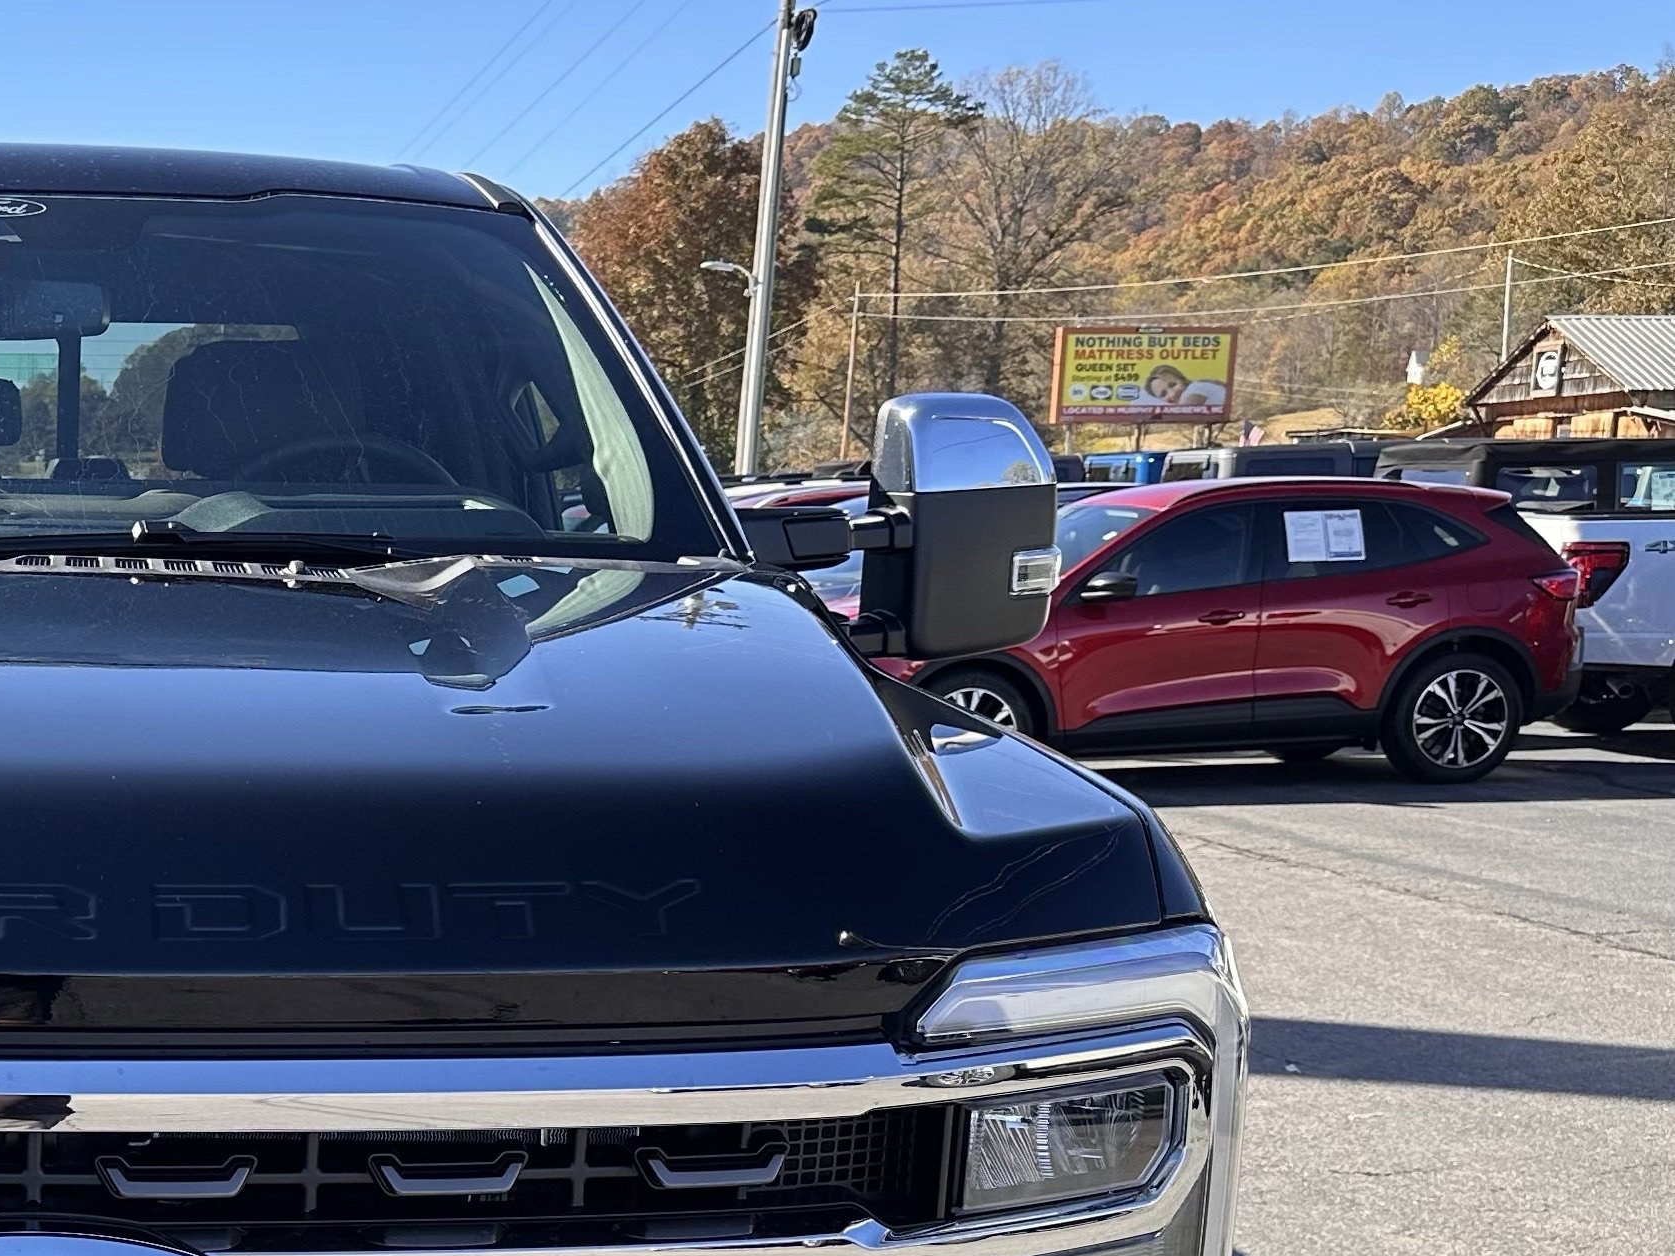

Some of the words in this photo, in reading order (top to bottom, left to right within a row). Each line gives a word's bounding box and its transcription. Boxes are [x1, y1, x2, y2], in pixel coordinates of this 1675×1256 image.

[1075, 336, 1143, 348] NOTHING
[1148, 336, 1178, 348] BUT
[1182, 335, 1221, 347] BEDS
[1074, 349, 1154, 361] MATTRESS
[1159, 348, 1220, 360] OUTLET
[1075, 363, 1114, 373] QUEEN
[1115, 363, 1137, 373] SET
[1113, 373, 1140, 382] $499
[152, 878, 701, 940] DUTY
